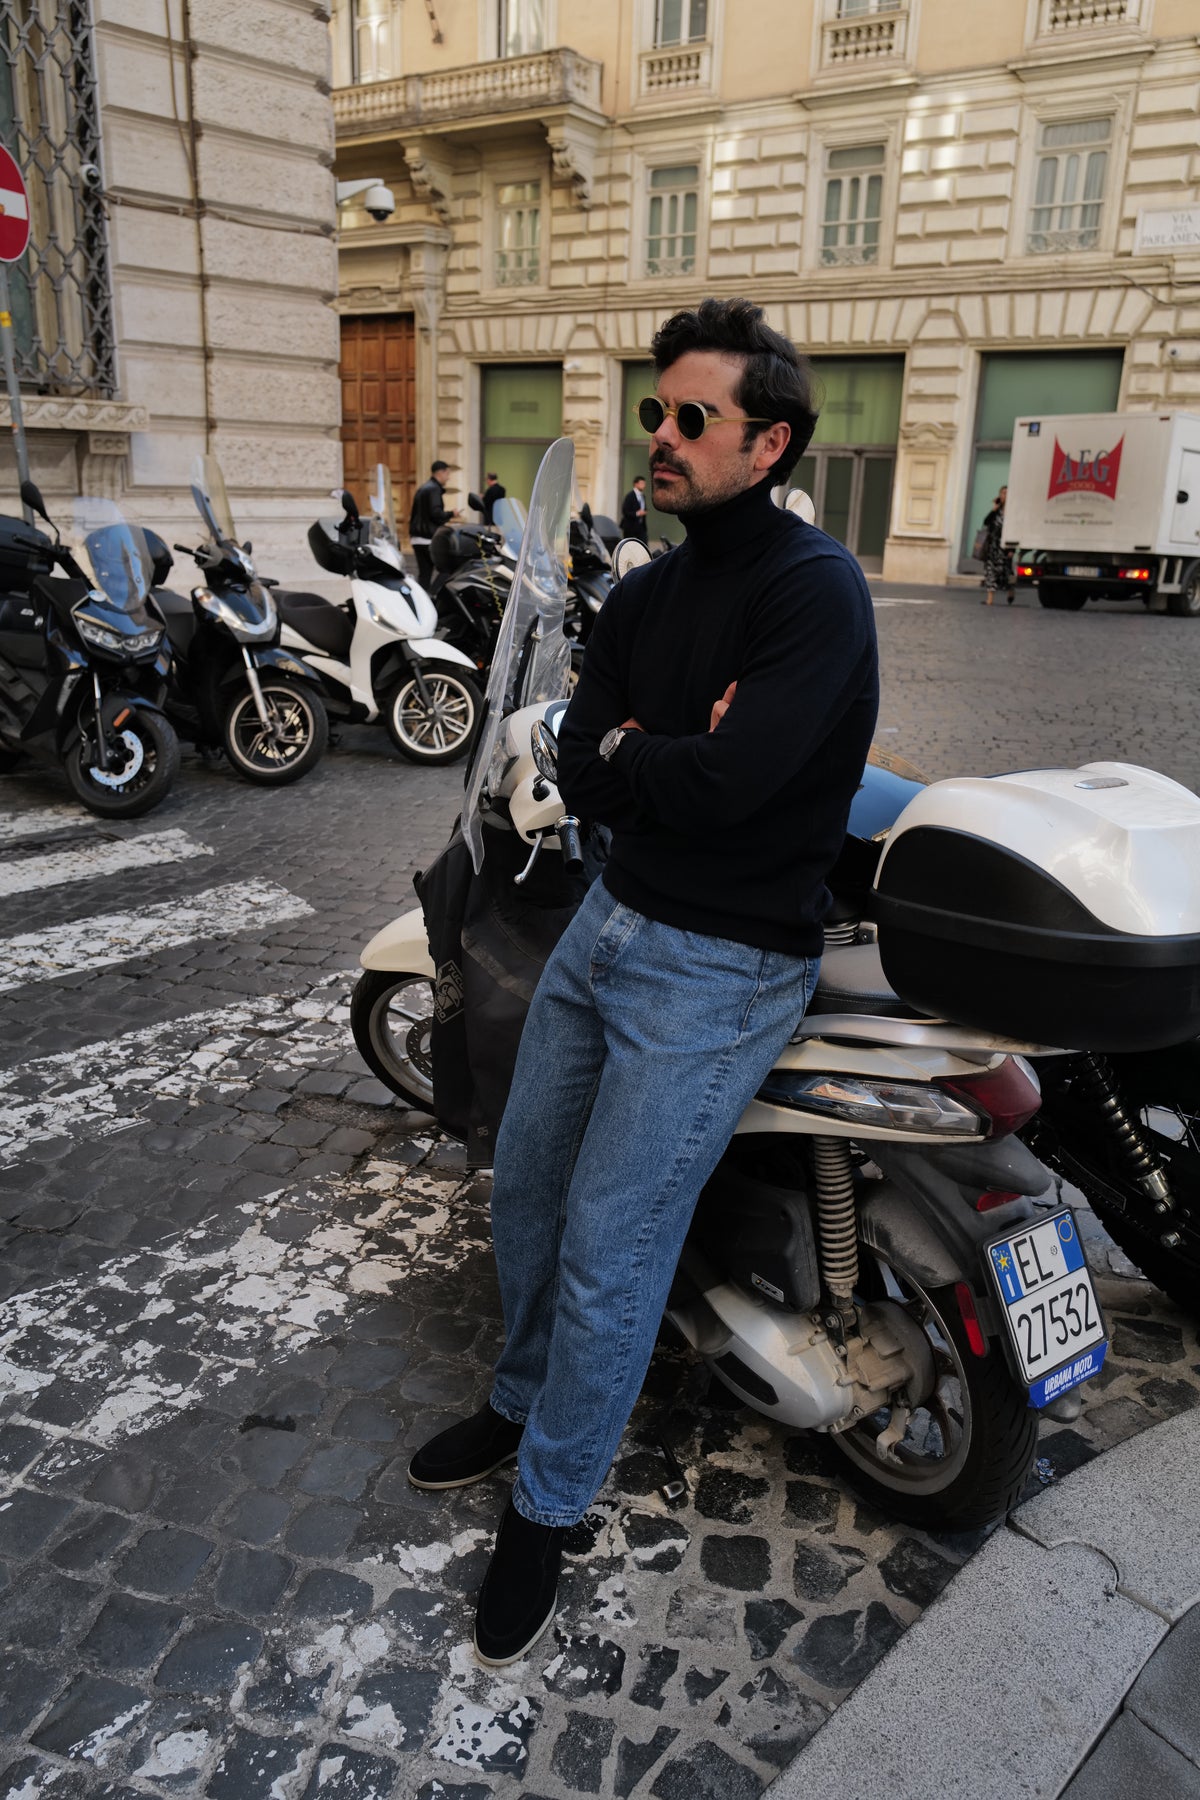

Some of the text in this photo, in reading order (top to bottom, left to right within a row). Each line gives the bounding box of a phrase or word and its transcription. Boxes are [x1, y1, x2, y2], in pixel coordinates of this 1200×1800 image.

[1172, 214, 1193, 224] VIA
[1056, 449, 1110, 485] AEG
[1013, 1235, 1054, 1289] EL
[1017, 1283, 1097, 1365] 27532
[1044, 1365, 1073, 1395] URBANA
[1073, 1354, 1093, 1378] MOTO
